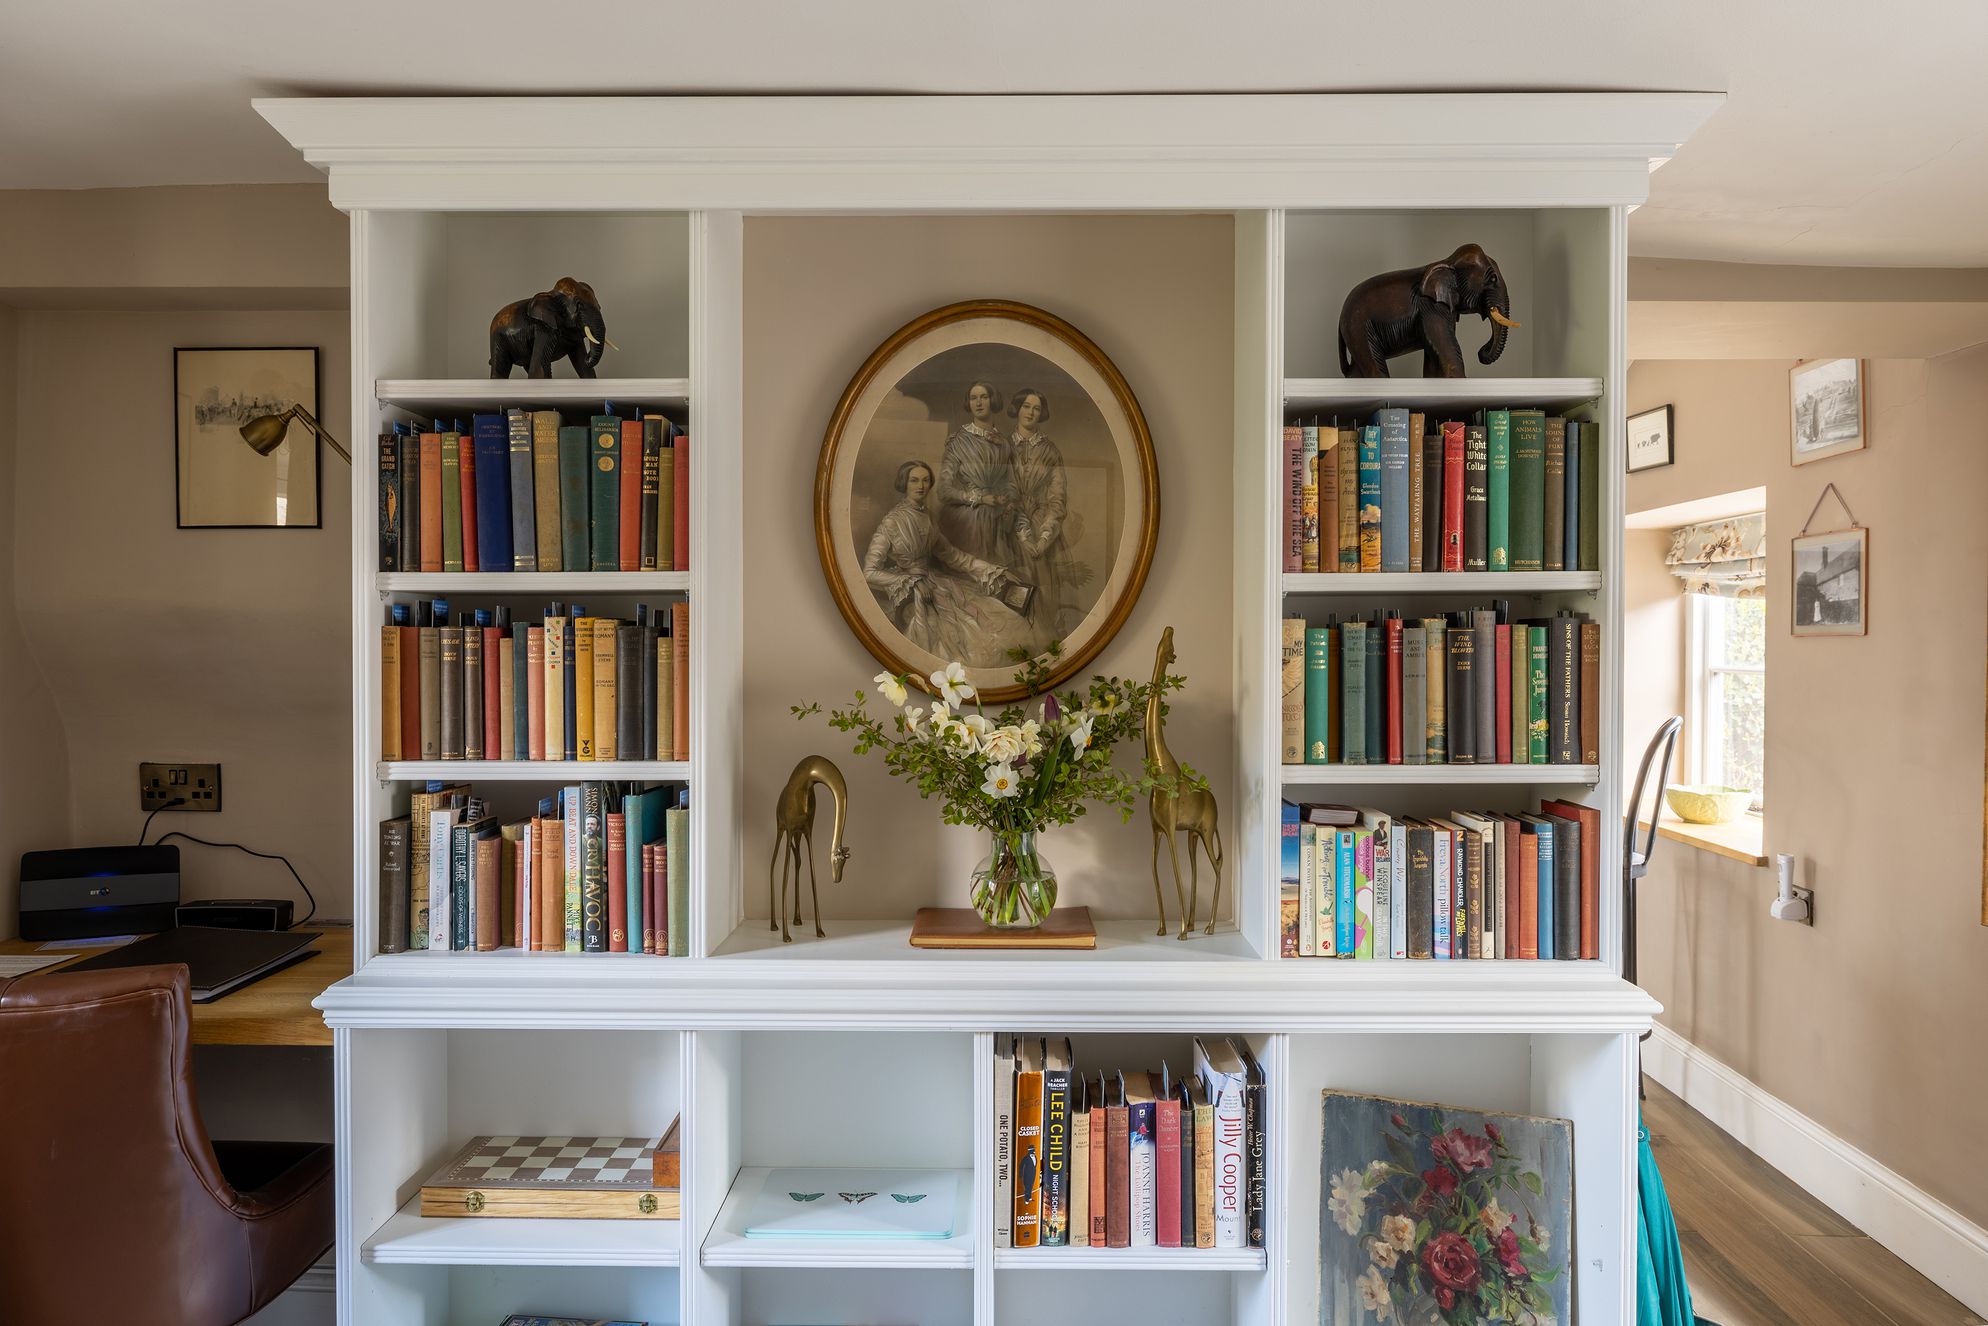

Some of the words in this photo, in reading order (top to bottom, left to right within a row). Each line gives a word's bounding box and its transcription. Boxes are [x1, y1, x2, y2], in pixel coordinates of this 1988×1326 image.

[1383, 422, 1407, 430] Crossing
[1471, 431, 1483, 440] The
[383, 447, 392, 455] THE
[1466, 439, 1488, 451] Tight
[1466, 450, 1488, 460] White
[381, 462, 396, 470] CATCH
[1291, 448, 1302, 466] THE
[1413, 451, 1421, 472] TREE
[1466, 461, 1488, 471] Collar
[1291, 469, 1302, 496] WIND
[1469, 485, 1484, 493] Grace
[1291, 499, 1302, 516] OFF
[1413, 476, 1421, 523] WAYFARING
[1291, 518, 1302, 536] THE
[1413, 526, 1421, 543] THE
[1291, 539, 1302, 557] SEA
[1466, 558, 1487, 566] Muller
[1564, 623, 1572, 639] SINS
[1283, 647, 1304, 657] TIME
[1564, 639, 1572, 649] OF
[1564, 651, 1572, 666] THE
[1564, 667, 1572, 698] FATHERS
[1563, 701, 1571, 719] Susan
[569, 795, 577, 806] UP
[590, 787, 598, 814] SIMON
[569, 808, 577, 828] BEAT
[434, 821, 447, 845] Tony
[455, 829, 468, 853] DOROTHY
[568, 829, 577, 845] AND
[568, 846, 577, 870] DOWN
[586, 838, 597, 862] CRY
[1343, 852, 1351, 865] ALAN
[1437, 839, 1449, 866] Freya
[435, 848, 447, 880] Curtis
[455, 861, 468, 882] SAYERS
[1318, 873, 1333, 901] Trouble
[1343, 866, 1351, 899] TITCHMARSH
[1439, 867, 1449, 895] North
[585, 864, 601, 931] HAVOC
[1456, 877, 1464, 907] CHANDLER
[1437, 898, 1449, 924] pillow
[1439, 927, 1449, 944] talk
[1050, 1092, 1064, 1120] LEE
[1196, 1108, 1212, 1116] THE
[998, 1114, 1009, 1130] ONE
[1218, 1115, 1242, 1148] Jilly
[996, 1132, 1009, 1162] POTATO,
[1049, 1124, 1063, 1171] CHILD
[1252, 1130, 1265, 1157] Grey
[998, 1164, 1009, 1187] TWO...
[1141, 1151, 1151, 1194] JOANNE
[1252, 1160, 1265, 1181] Jane
[1051, 1174, 1059, 1195] NIGHT
[1133, 1175, 1142, 1208] Lollipop
[1218, 1153, 1242, 1212] Cooper
[1252, 1184, 1265, 1211] Lady
[1050, 1196, 1059, 1225] SCHOOL
[1134, 1210, 1142, 1232] Shoes
[1141, 1196, 1151, 1236] HARRIS
